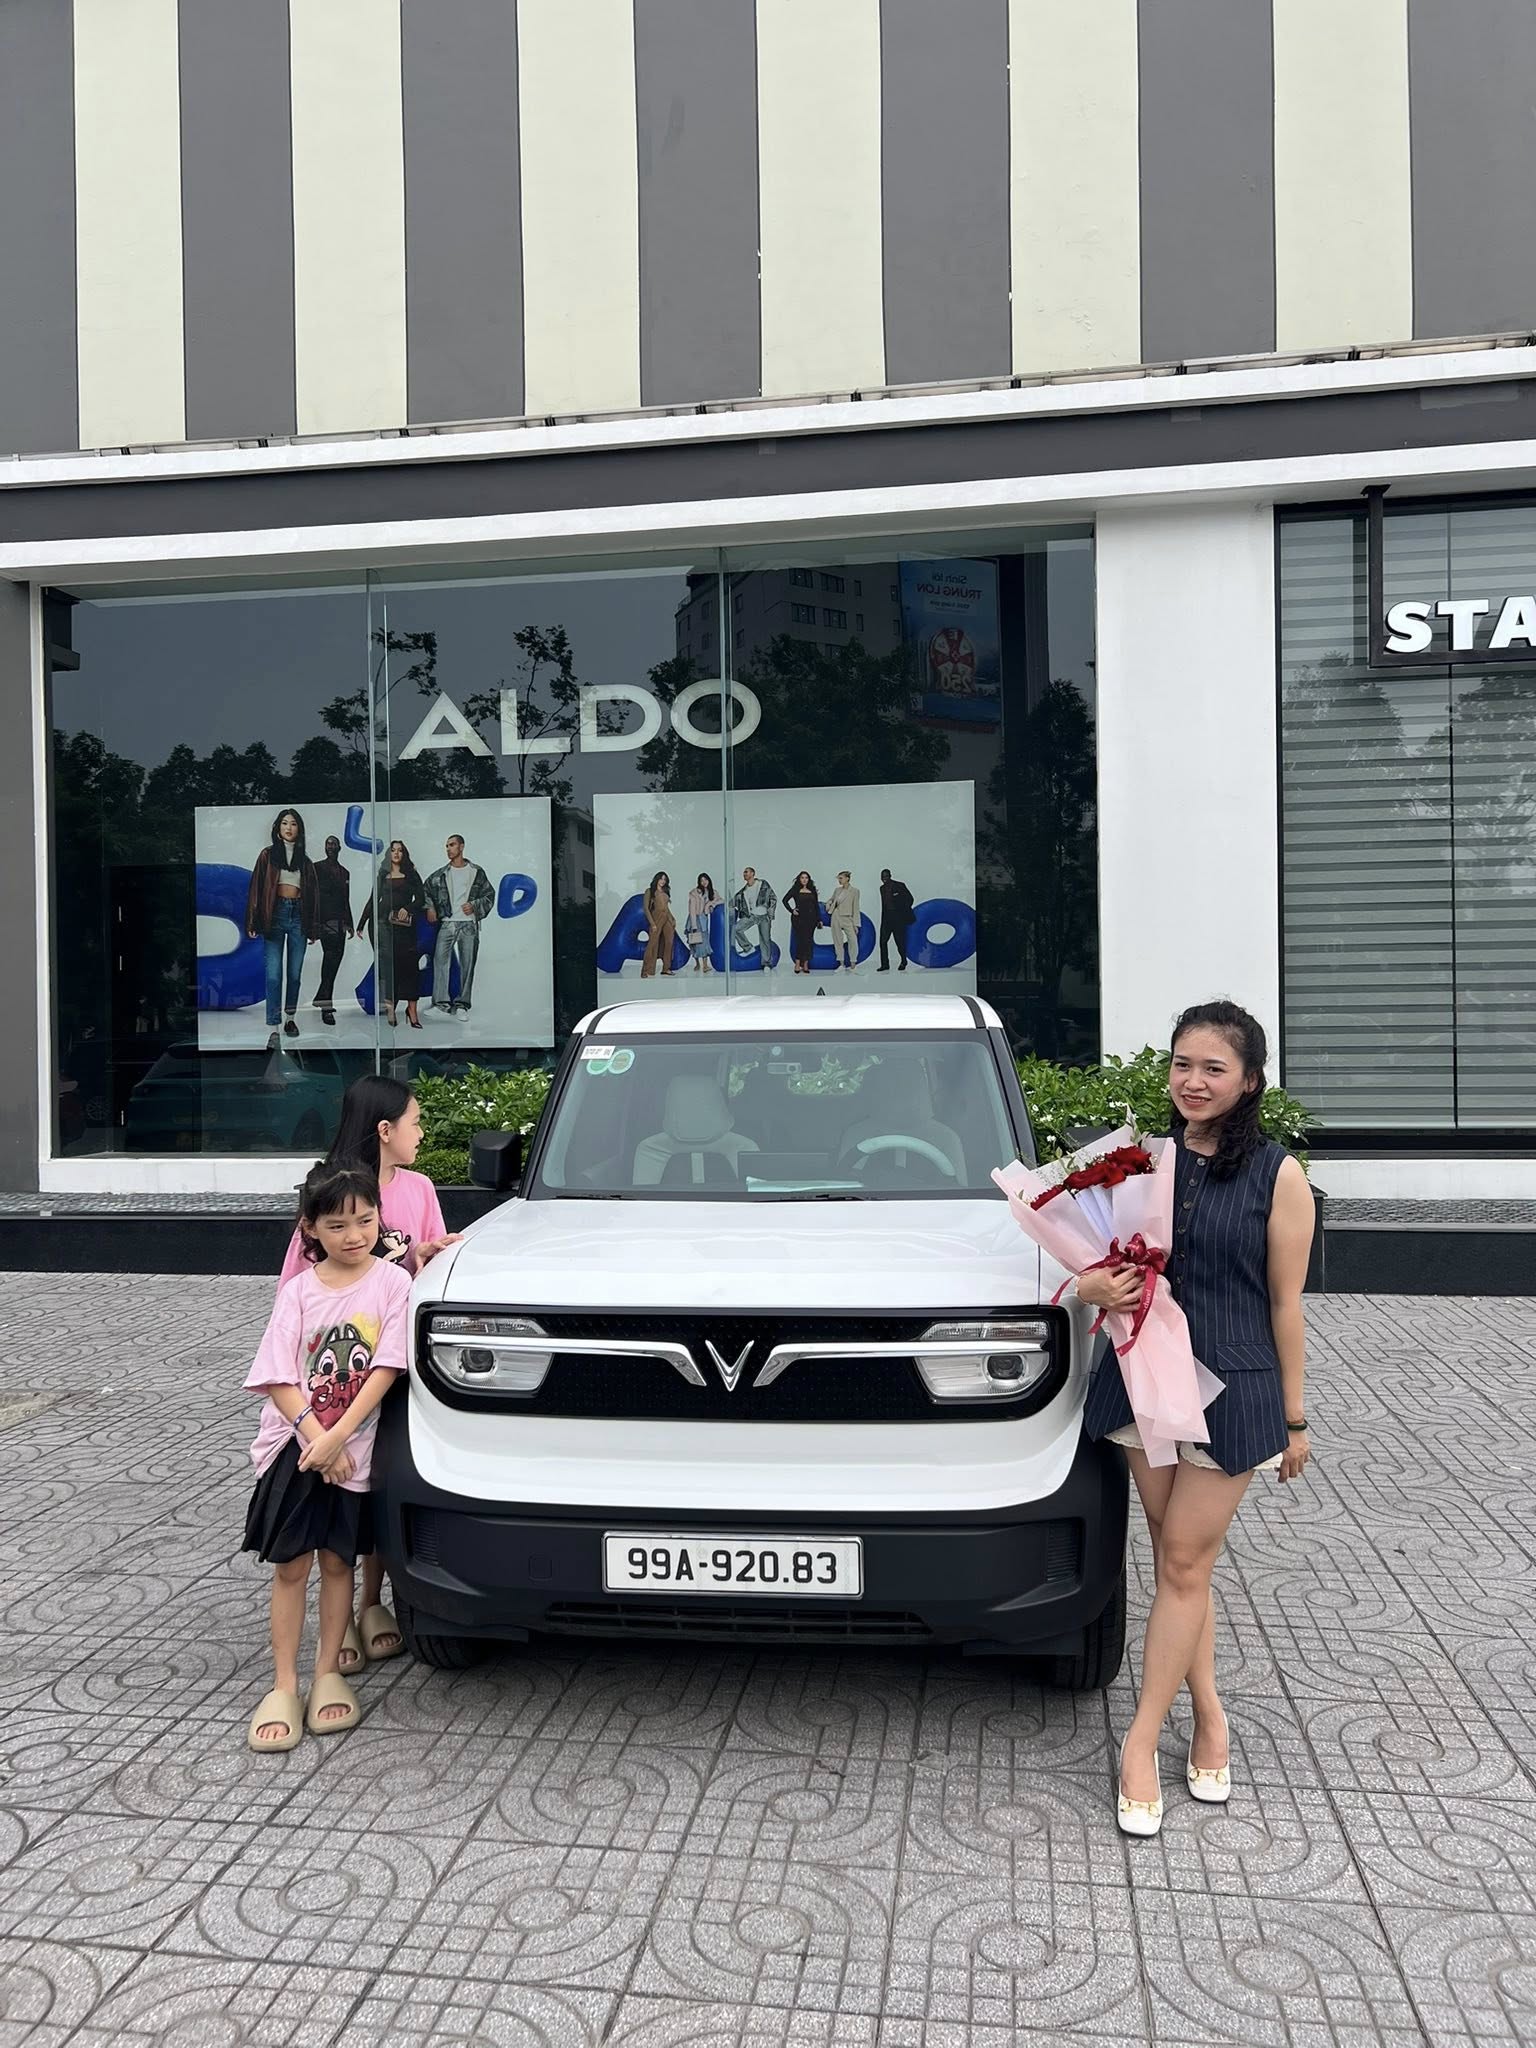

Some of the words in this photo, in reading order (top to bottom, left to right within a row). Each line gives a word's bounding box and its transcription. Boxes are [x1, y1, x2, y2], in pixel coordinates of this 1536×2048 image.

[1385, 596, 1536, 653] STA
[398, 679, 762, 760] ALDO
[628, 1547, 837, 1584] 99A-920.83
